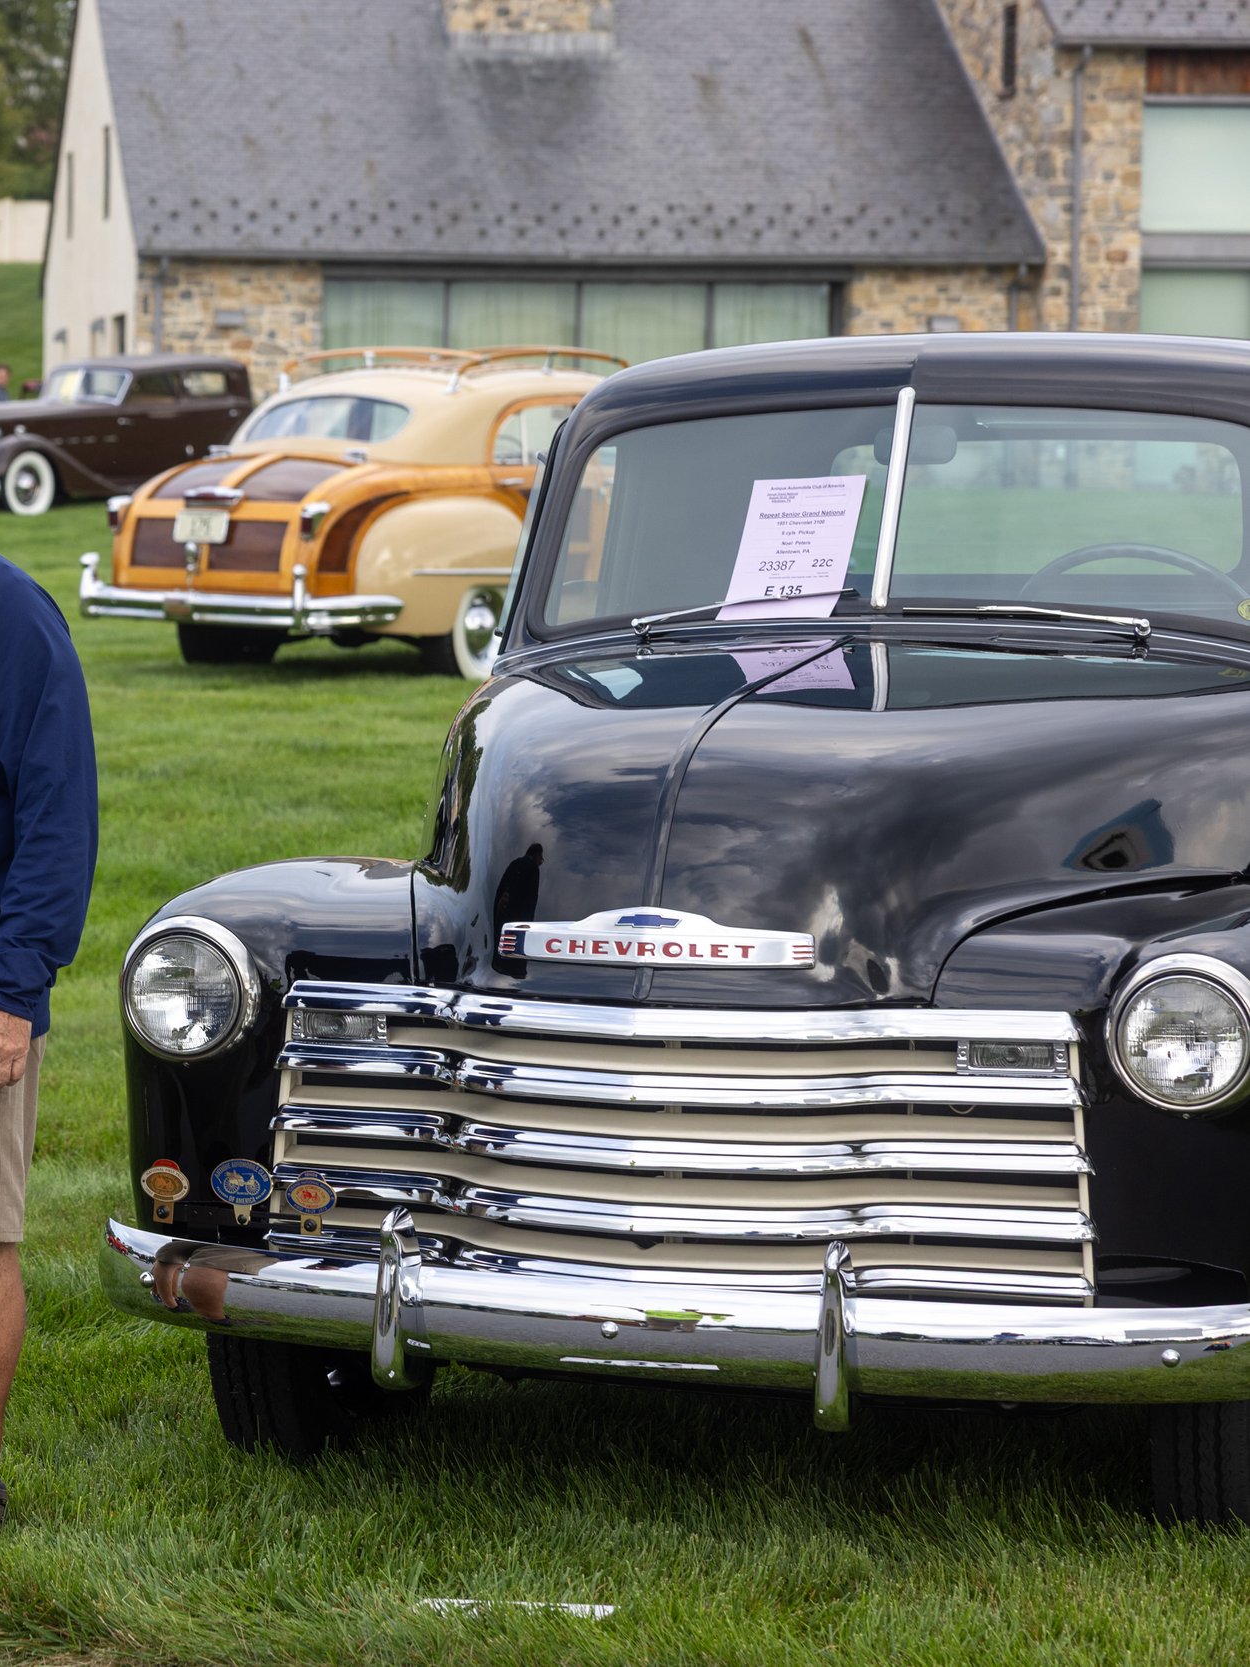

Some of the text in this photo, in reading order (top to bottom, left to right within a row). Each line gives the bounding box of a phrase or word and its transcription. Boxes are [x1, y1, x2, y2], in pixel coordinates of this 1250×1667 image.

[758, 558, 833, 571] 23387 22C
[764, 585, 803, 597] E 135
[545, 938, 755, 959] CHEVROLET
